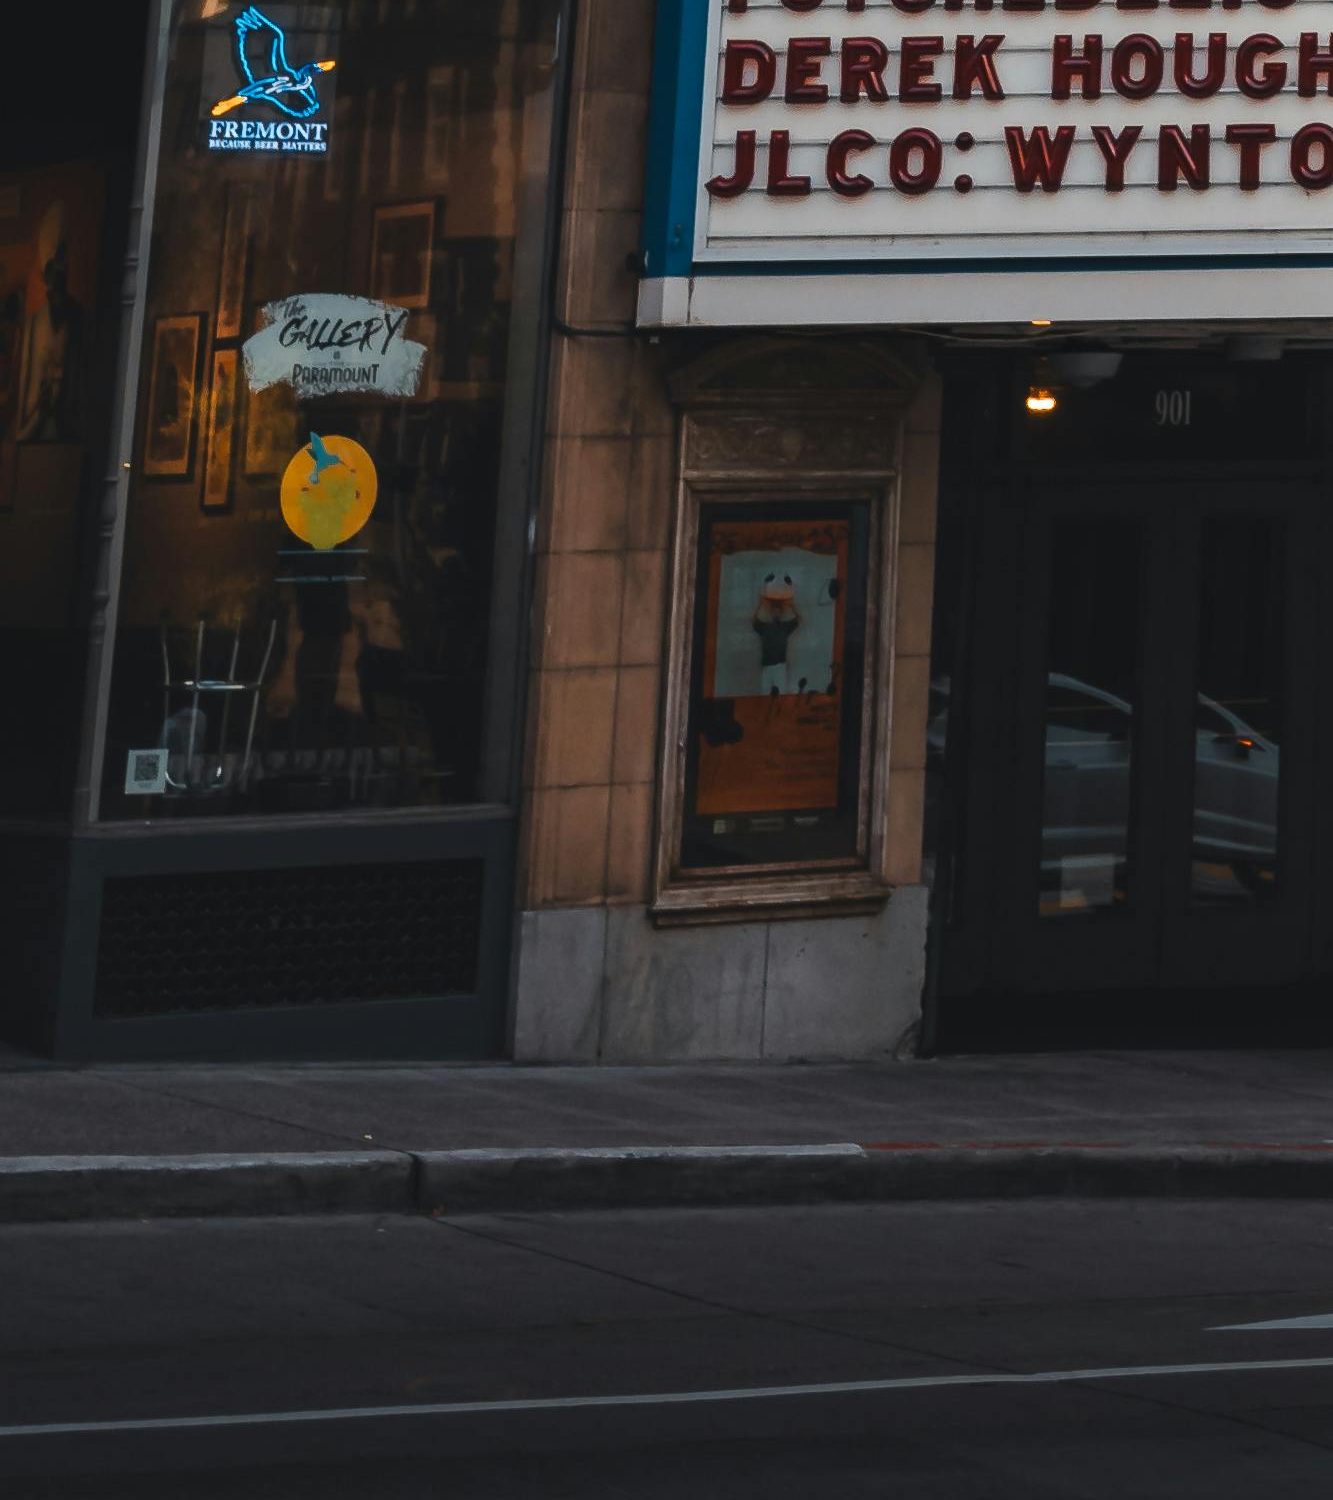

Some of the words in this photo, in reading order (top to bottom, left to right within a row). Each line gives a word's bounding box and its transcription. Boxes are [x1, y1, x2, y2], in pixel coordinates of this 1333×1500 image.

[722, 35, 1006, 111] DEREK
[209, 119, 328, 141] FREMONT
[209, 138, 251, 150] BECAUSE
[254, 139, 280, 150] BEER
[283, 140, 327, 152] MATTERS
[706, 128, 975, 203] JLCO:
[278, 309, 410, 356] GALLERY
[292, 363, 380, 385] PARAMOUNT
[1155, 389, 1191, 426] 901
